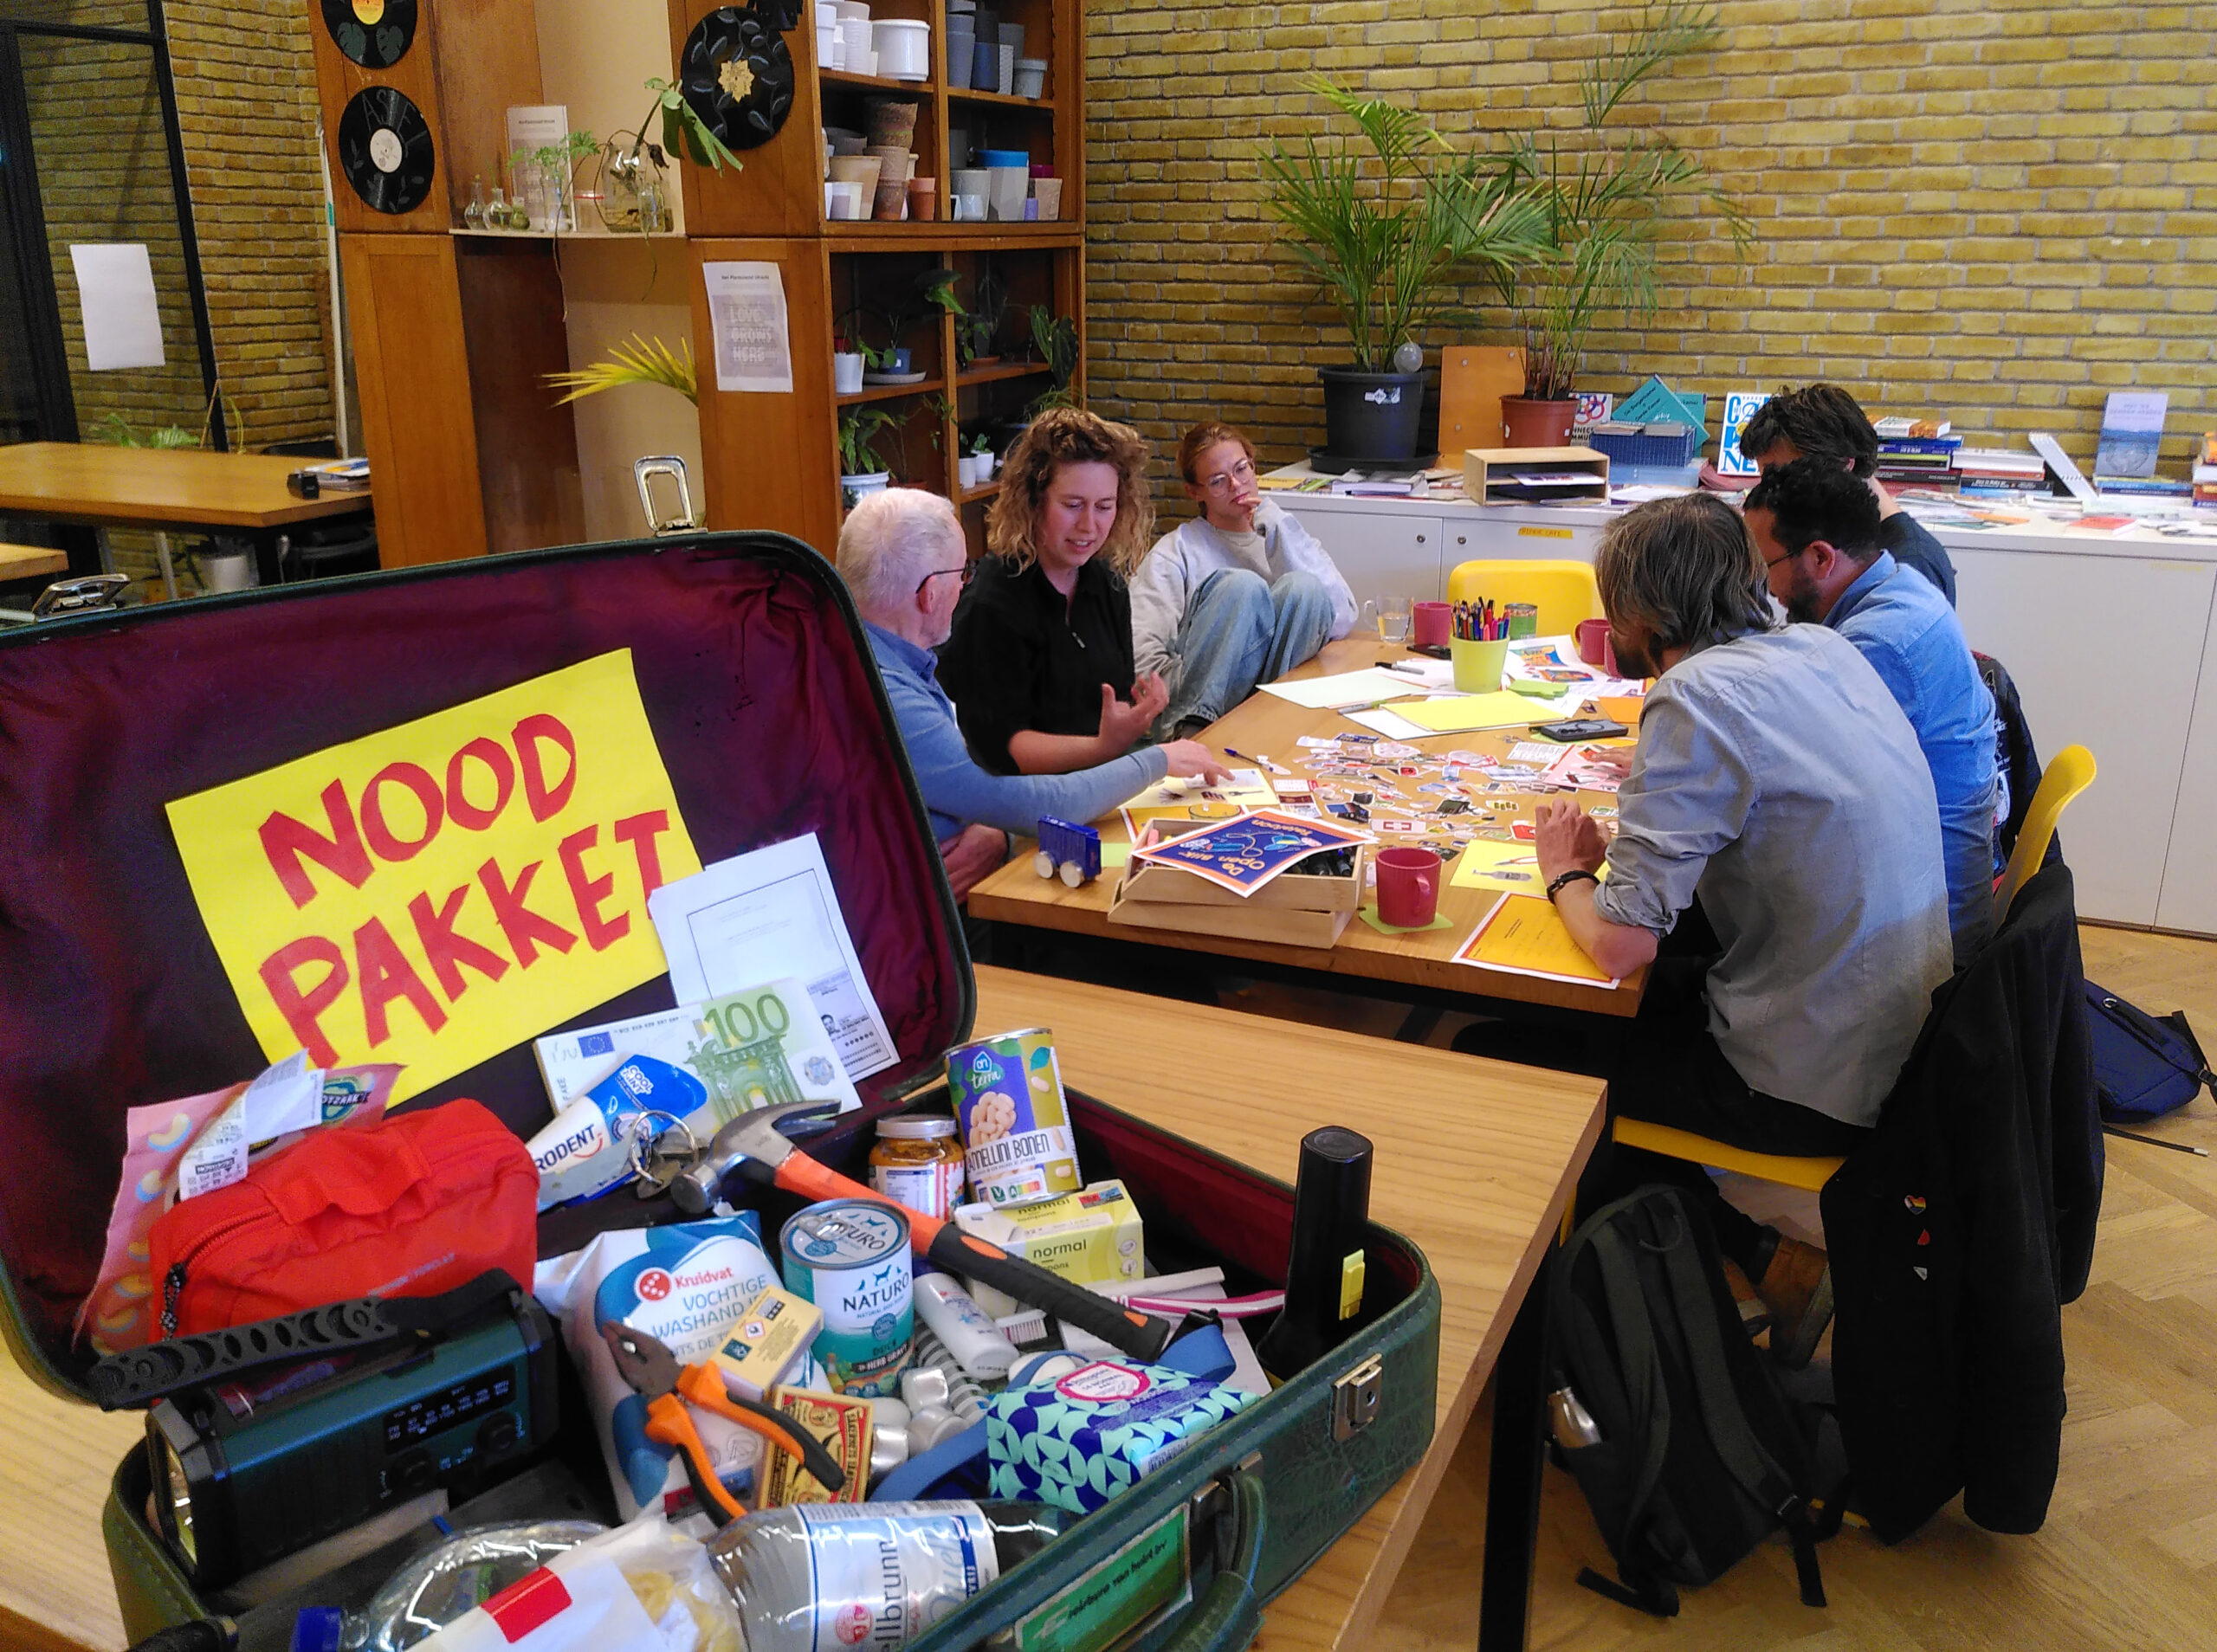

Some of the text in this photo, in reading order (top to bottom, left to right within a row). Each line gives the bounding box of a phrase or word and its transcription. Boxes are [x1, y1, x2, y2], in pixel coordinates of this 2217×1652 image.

[257, 713, 577, 911] NOOD
[1218, 855, 1265, 870] Open
[1221, 862, 1245, 877] De
[257, 809, 670, 1070] PAKKET
[704, 993, 790, 1049] 100
[629, 1065, 653, 1090] COOL
[972, 1071, 1001, 1087] terra
[535, 1124, 596, 1171] RODENT
[1013, 1133, 1050, 1158] BONEN
[1018, 1198, 1070, 1214] normal
[1033, 1239, 1087, 1258] normal
[675, 1267, 734, 1287] Kruidvat
[683, 1274, 767, 1311] VOCHTIGE
[843, 1272, 909, 1312] NATURO
[698, 1339, 715, 1351] DE
[867, 1356, 888, 1371] HERB
[887, 1342, 908, 1362] GRAVY
